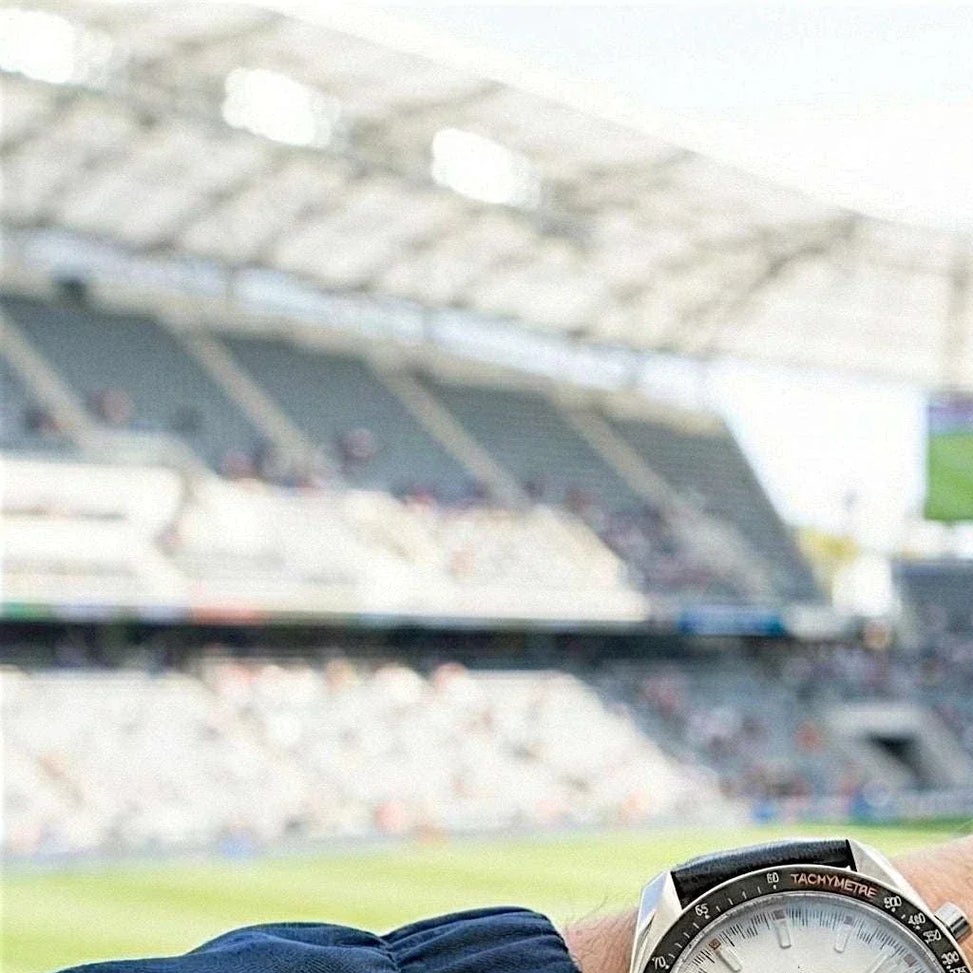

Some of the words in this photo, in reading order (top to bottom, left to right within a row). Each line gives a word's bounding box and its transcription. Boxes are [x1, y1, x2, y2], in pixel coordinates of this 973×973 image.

[790, 873, 878, 899] TACHYMETRE
[694, 903, 709, 916] 65
[652, 956, 666, 970] 70
